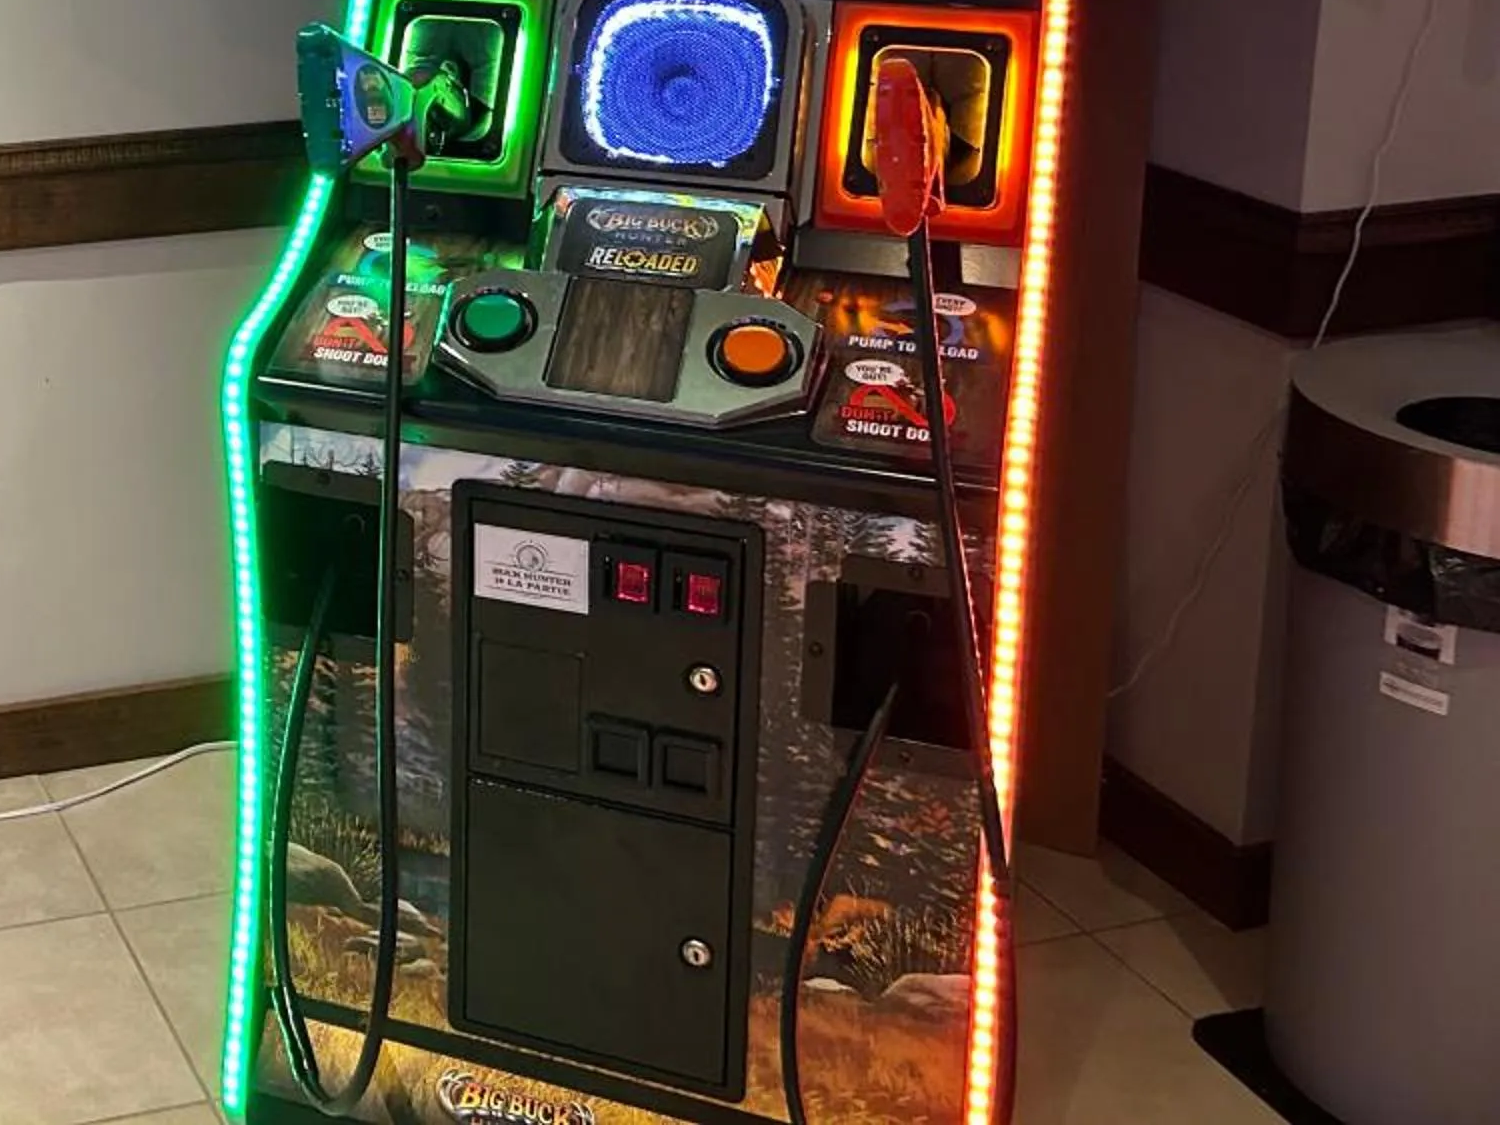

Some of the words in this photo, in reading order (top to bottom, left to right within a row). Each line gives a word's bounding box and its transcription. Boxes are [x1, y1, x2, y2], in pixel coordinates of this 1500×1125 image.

[606, 211, 644, 231] BIG
[648, 217, 703, 240] BUCK
[589, 246, 699, 273] RELOADED
[314, 347, 363, 363] SHOOT
[849, 335, 893, 349] PUMP
[898, 340, 916, 352] TO
[938, 346, 979, 360] LOAD
[846, 420, 902, 437] SHOOT
[507, 579, 522, 588] LA
[526, 582, 571, 596] PARTIE
[523, 573, 571, 587] HUNTER
[459, 1082, 505, 1109] BIG
[508, 1094, 570, 1125] BUCK
